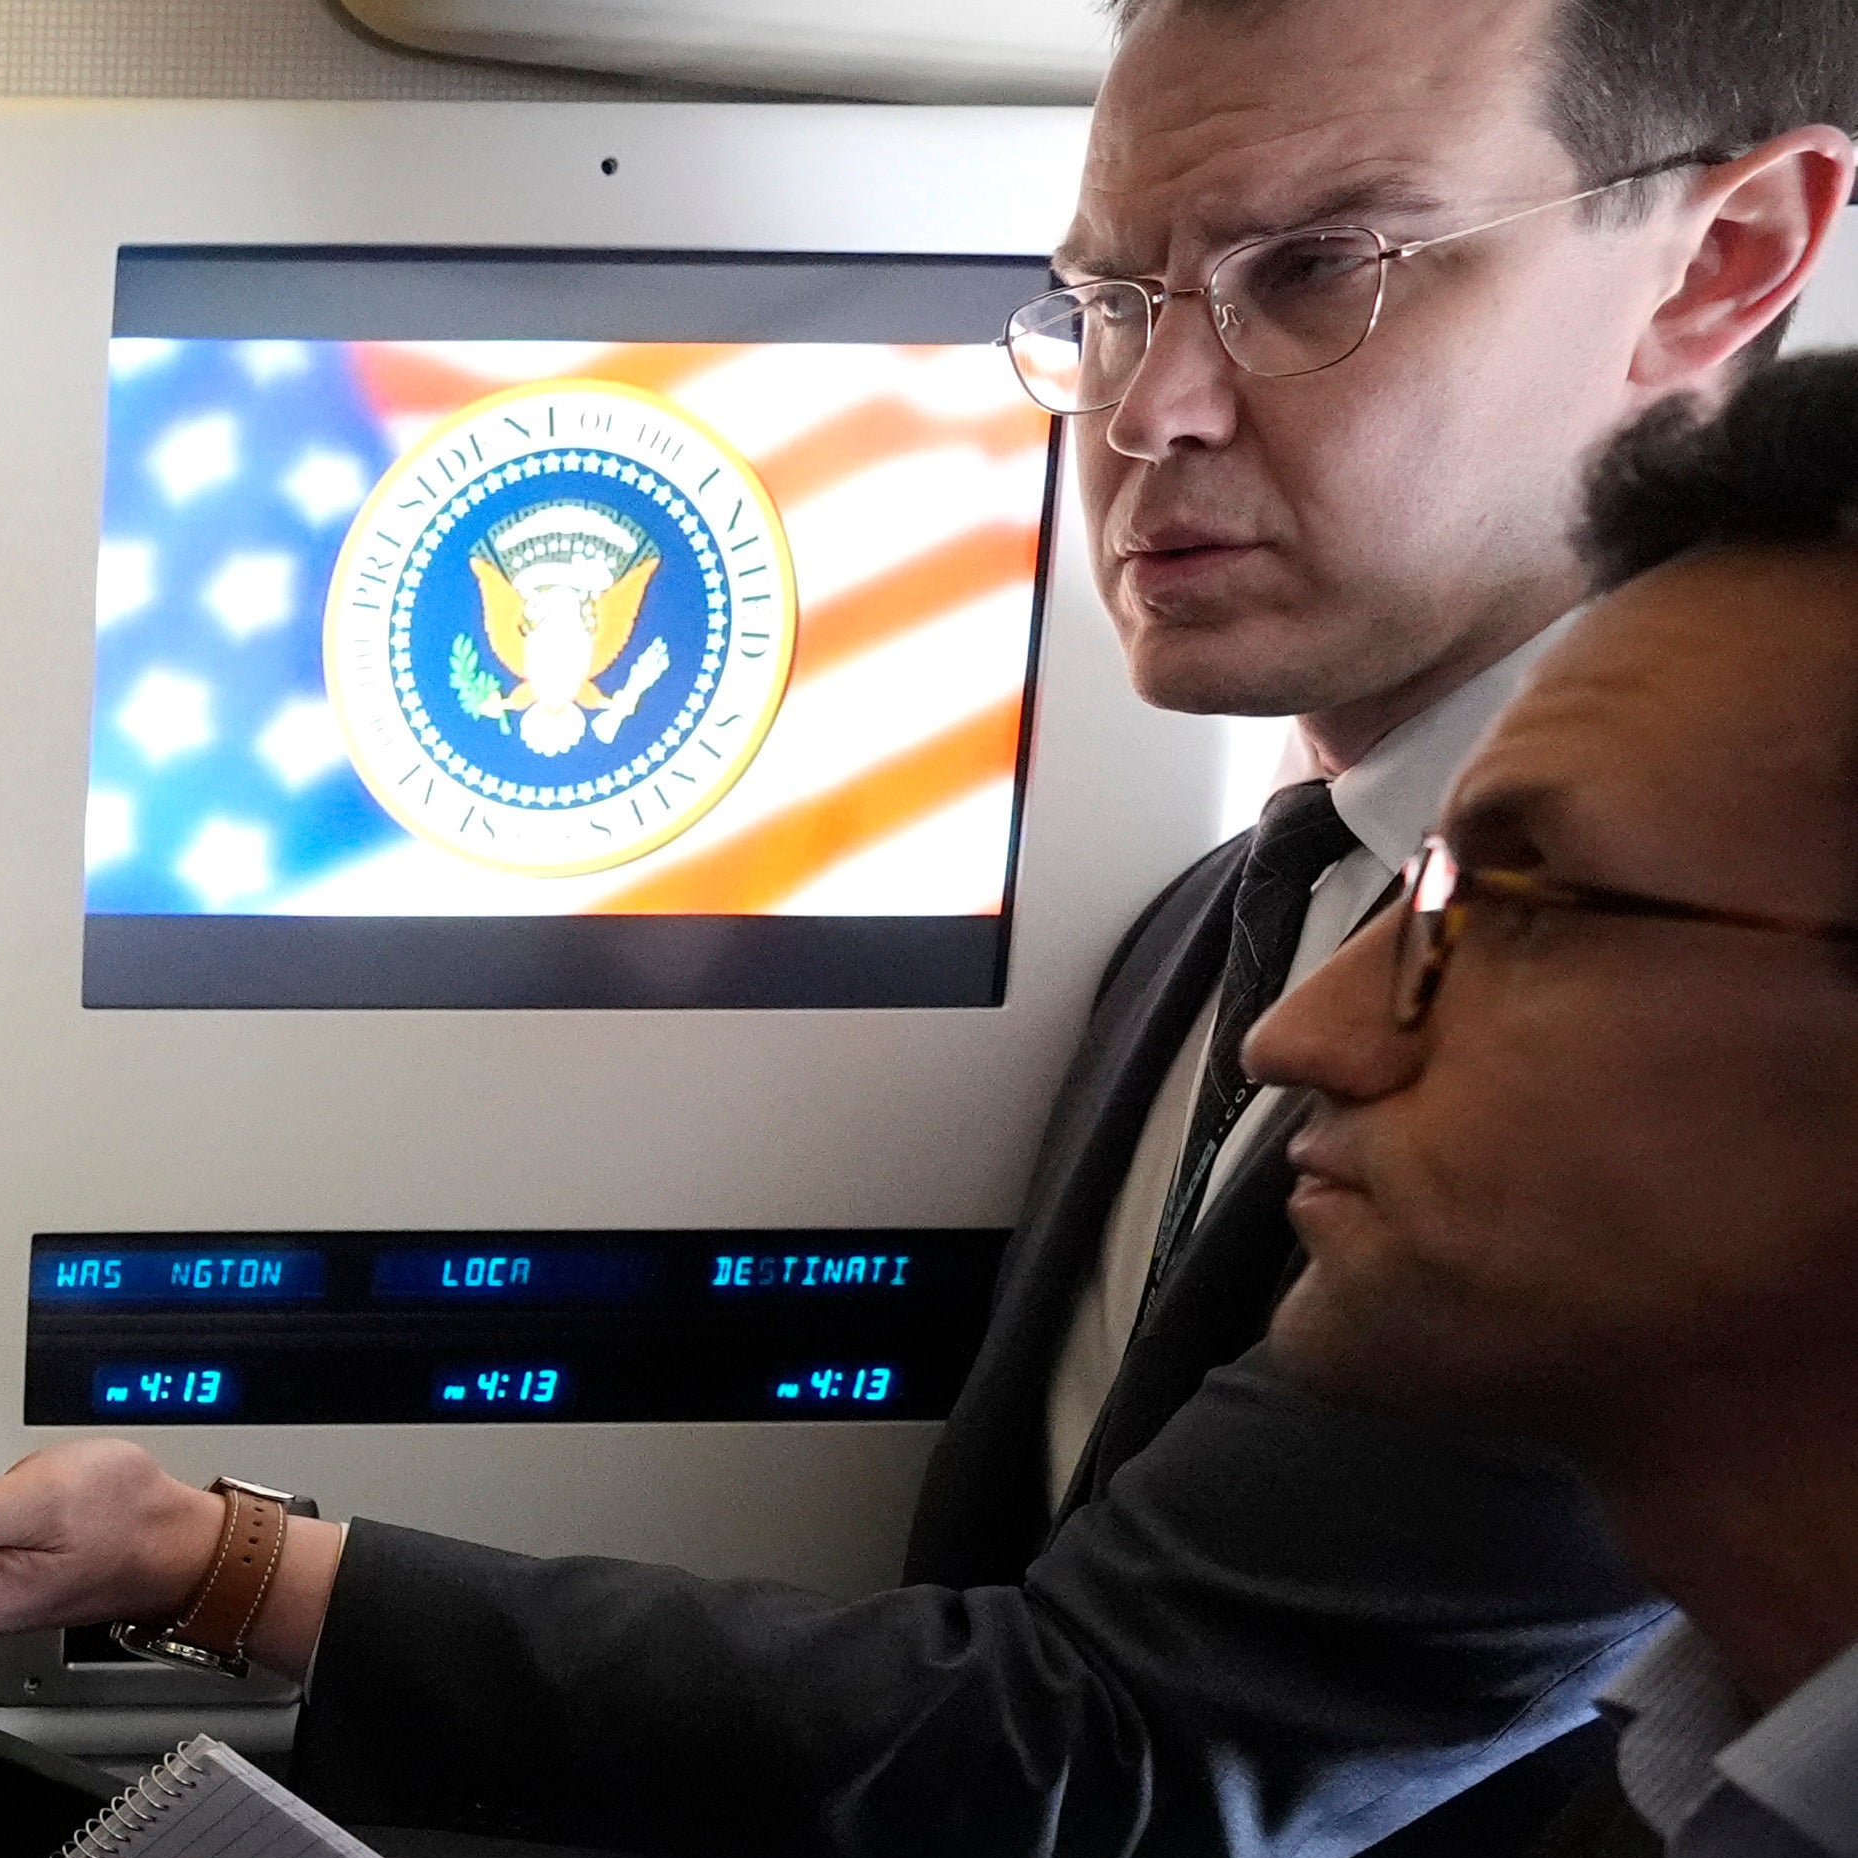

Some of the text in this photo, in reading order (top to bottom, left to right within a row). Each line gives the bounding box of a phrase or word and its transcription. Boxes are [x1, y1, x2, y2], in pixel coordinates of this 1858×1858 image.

[140, 1370, 222, 1404] 4:13
[477, 1368, 559, 1403] 4:13
[810, 1367, 892, 1402] 4:13
